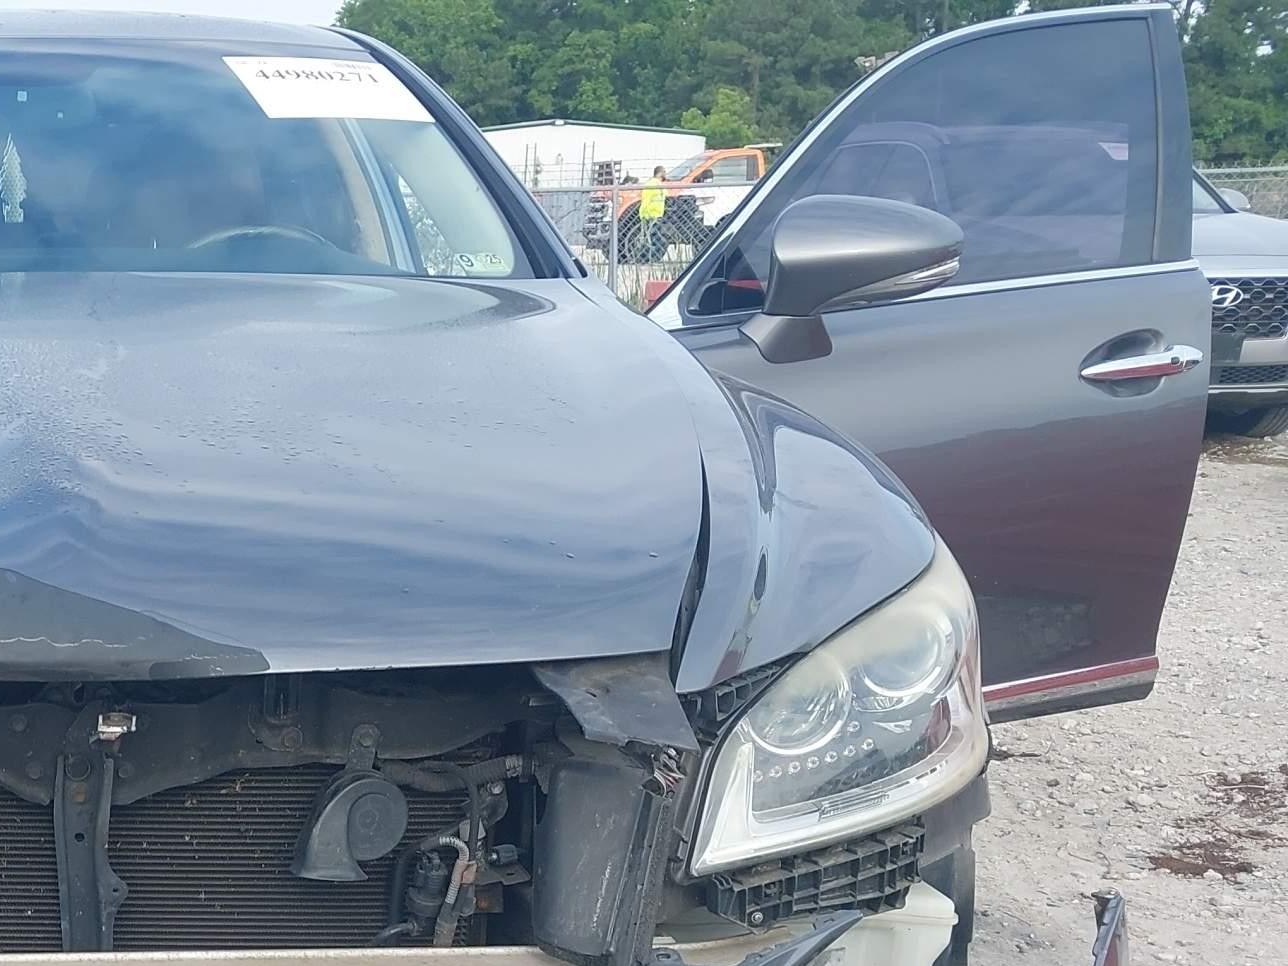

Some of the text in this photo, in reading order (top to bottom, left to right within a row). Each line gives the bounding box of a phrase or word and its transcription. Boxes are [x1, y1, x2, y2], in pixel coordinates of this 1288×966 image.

[255, 69, 380, 84] 44980271
[459, 254, 502, 267] 9 25
